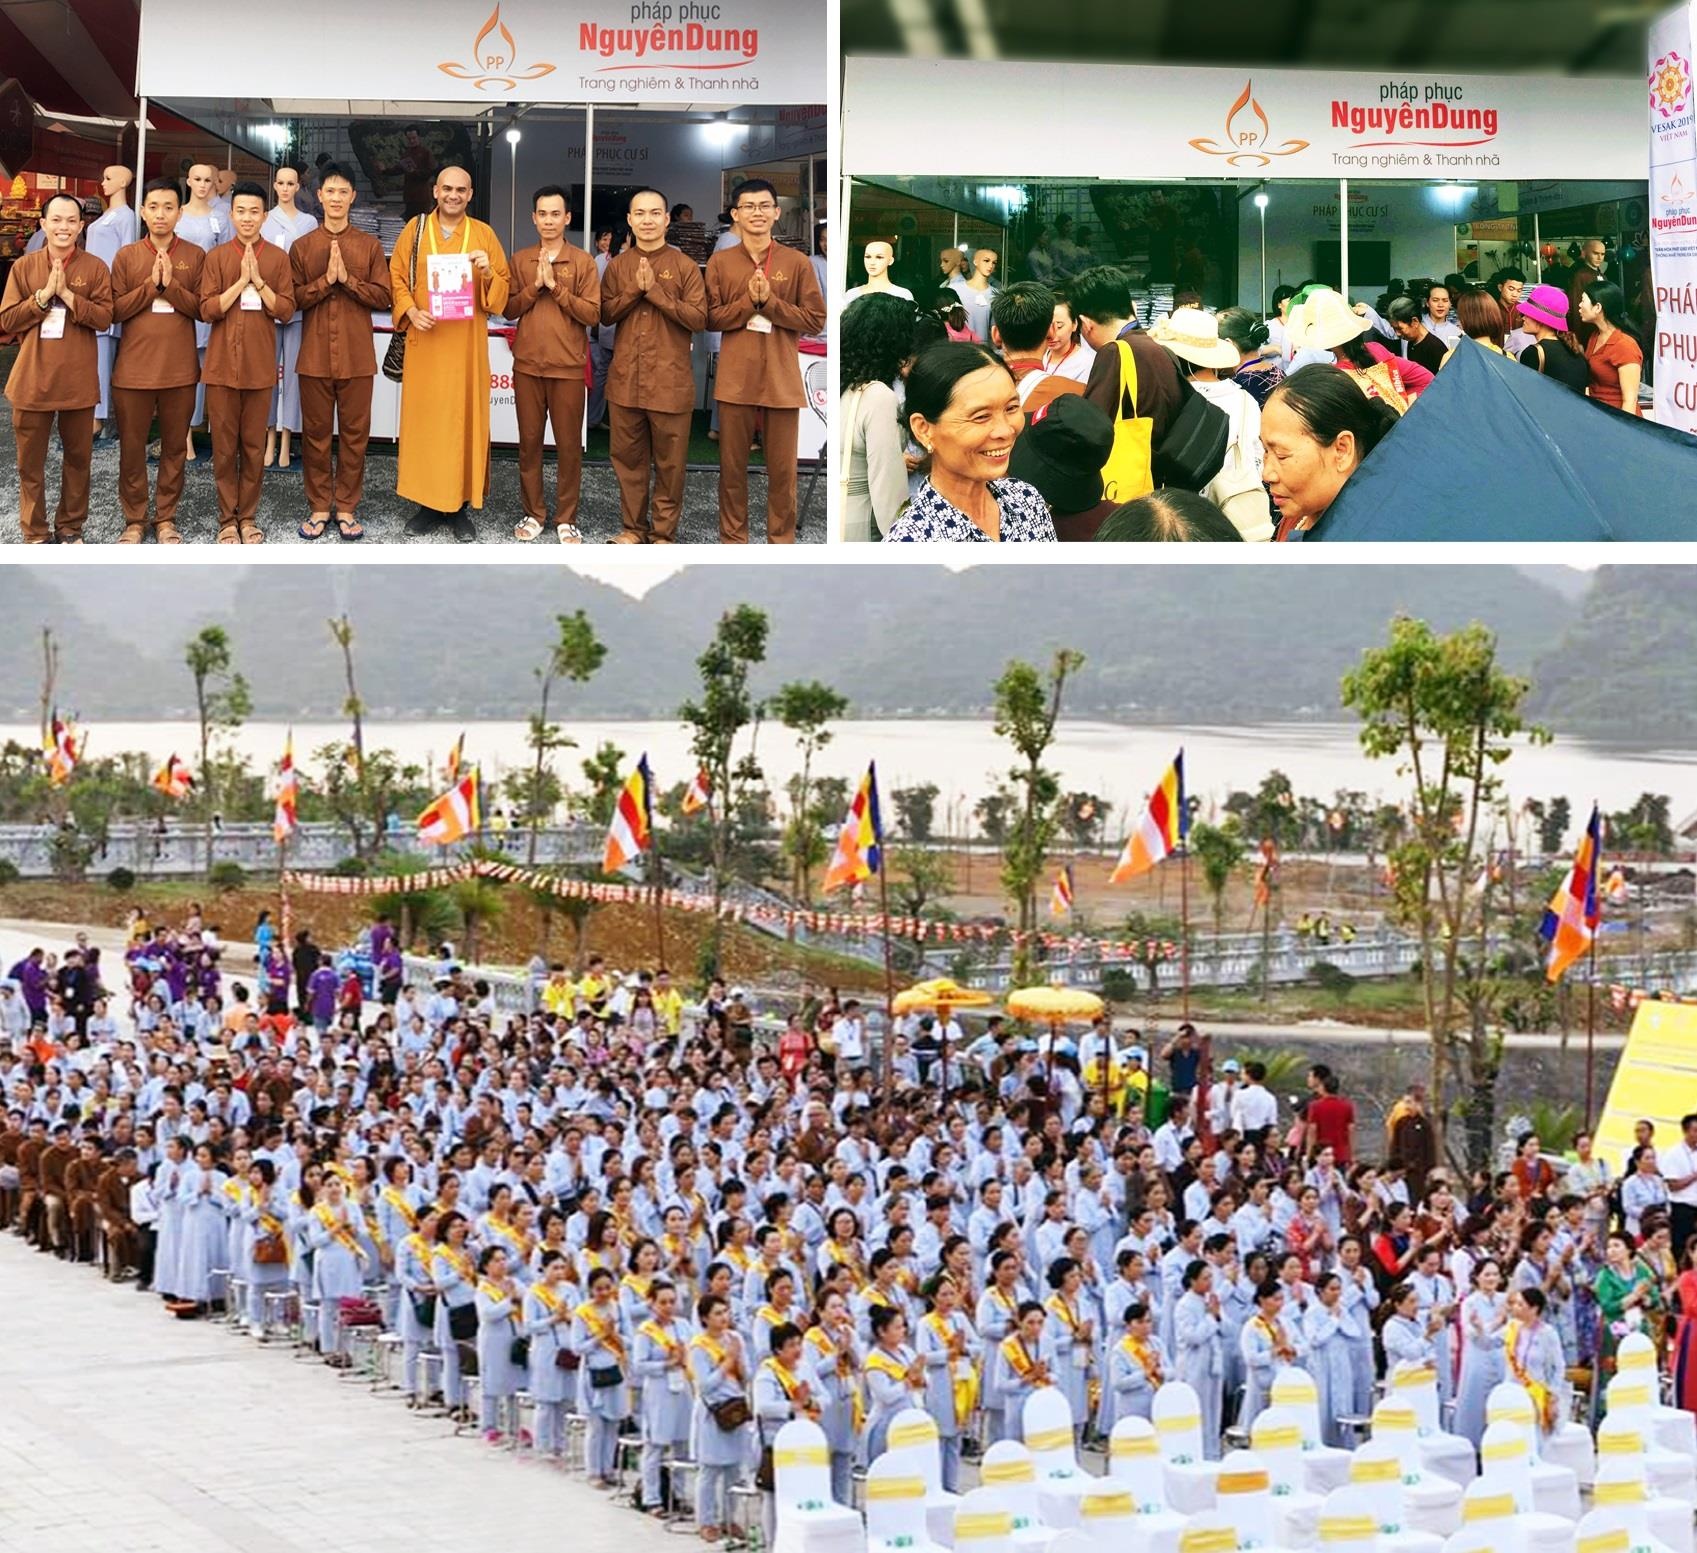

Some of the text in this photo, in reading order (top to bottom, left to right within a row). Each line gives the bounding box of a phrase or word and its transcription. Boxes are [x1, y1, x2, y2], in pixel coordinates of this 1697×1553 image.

[631, 1, 721, 23] pháp phục
[579, 22, 758, 57] NguyênDung
[486, 56, 504, 70] PP
[579, 77, 759, 91] Trang nghiêm & Thanh nhã
[1379, 81, 1463, 103] pháp phục
[1331, 101, 1498, 135] NguyênDung
[1651, 120, 1677, 133] VESAK
[1239, 132, 1258, 146] PP
[1332, 153, 1500, 168] Trang nghiêm & Thanh nhã
[1656, 282, 1697, 314] PHÁ
